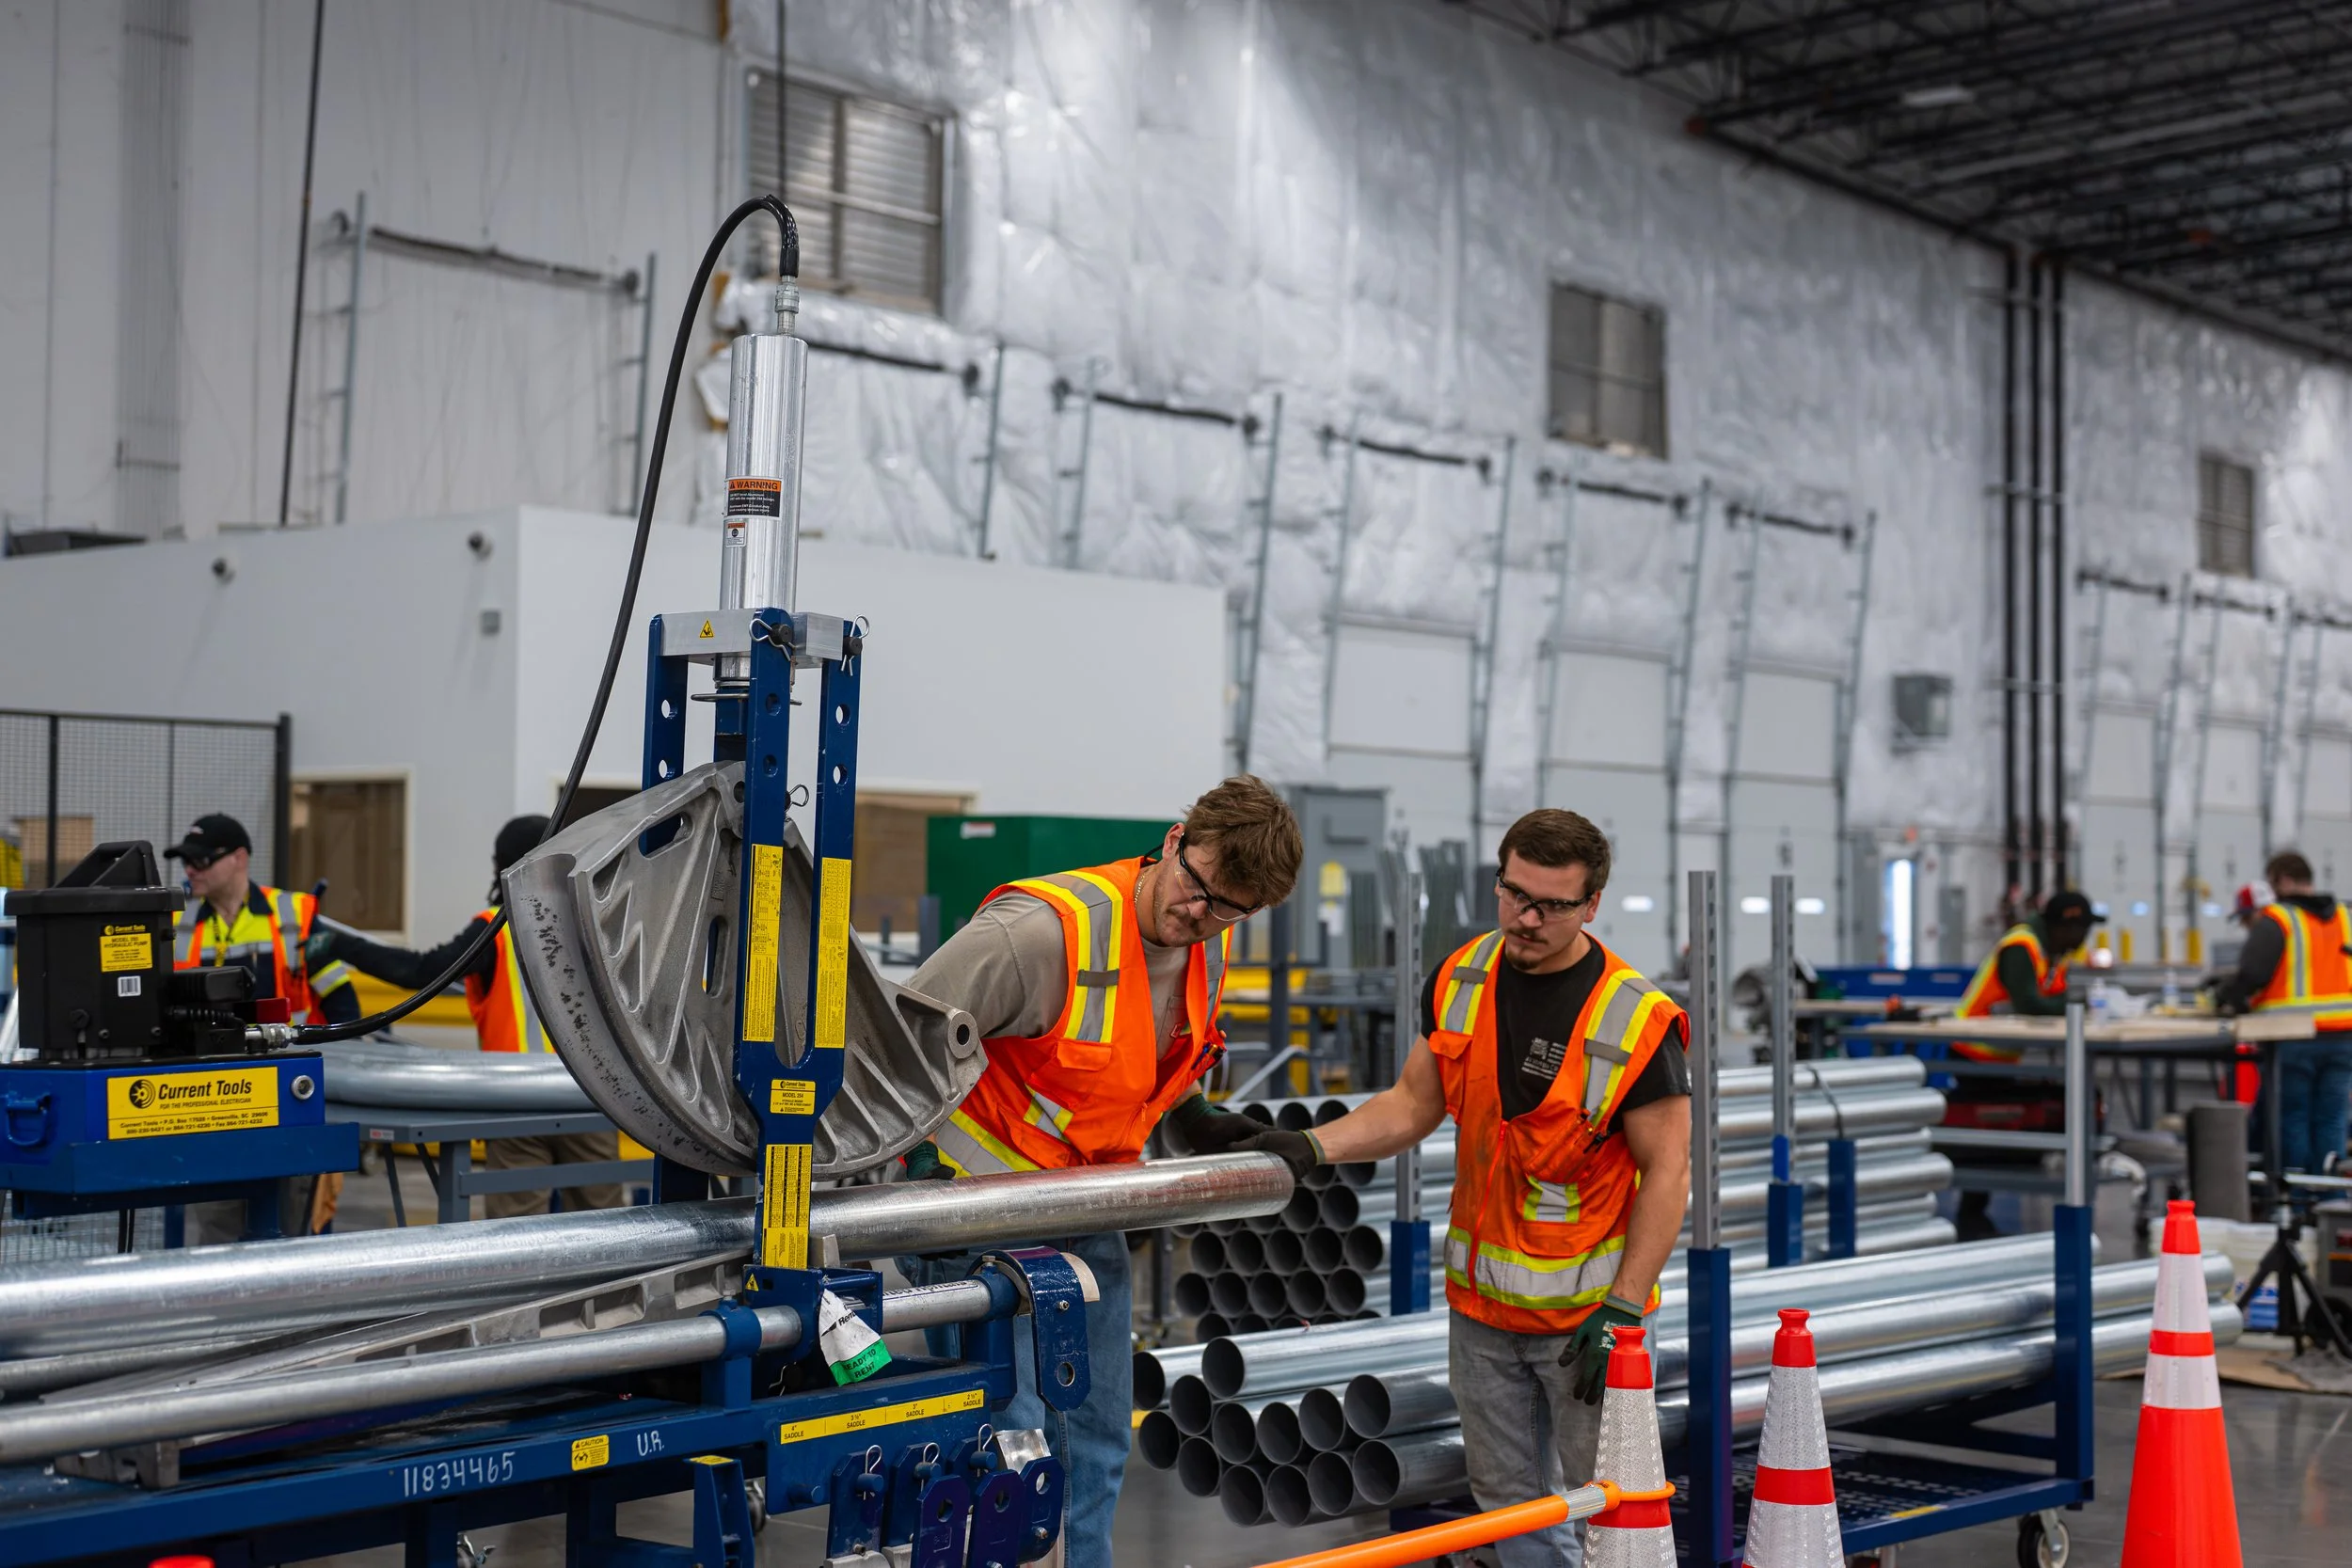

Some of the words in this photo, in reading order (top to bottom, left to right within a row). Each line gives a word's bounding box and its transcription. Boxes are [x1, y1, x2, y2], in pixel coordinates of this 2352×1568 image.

[737, 481, 778, 489] WARNING
[158, 1082, 212, 1100] Current
[216, 1079, 252, 1096] Tools
[867, 1349, 876, 1357] TO
[854, 1362, 875, 1378] RENT
[963, 1399, 981, 1407] SADDLE
[906, 1409, 924, 1418] SADDLE
[847, 1419, 866, 1428] SADDLE
[784, 1431, 804, 1439] SADDLE
[580, 1438, 603, 1447] CAUTION
[404, 1451, 516, 1497] 11834465
